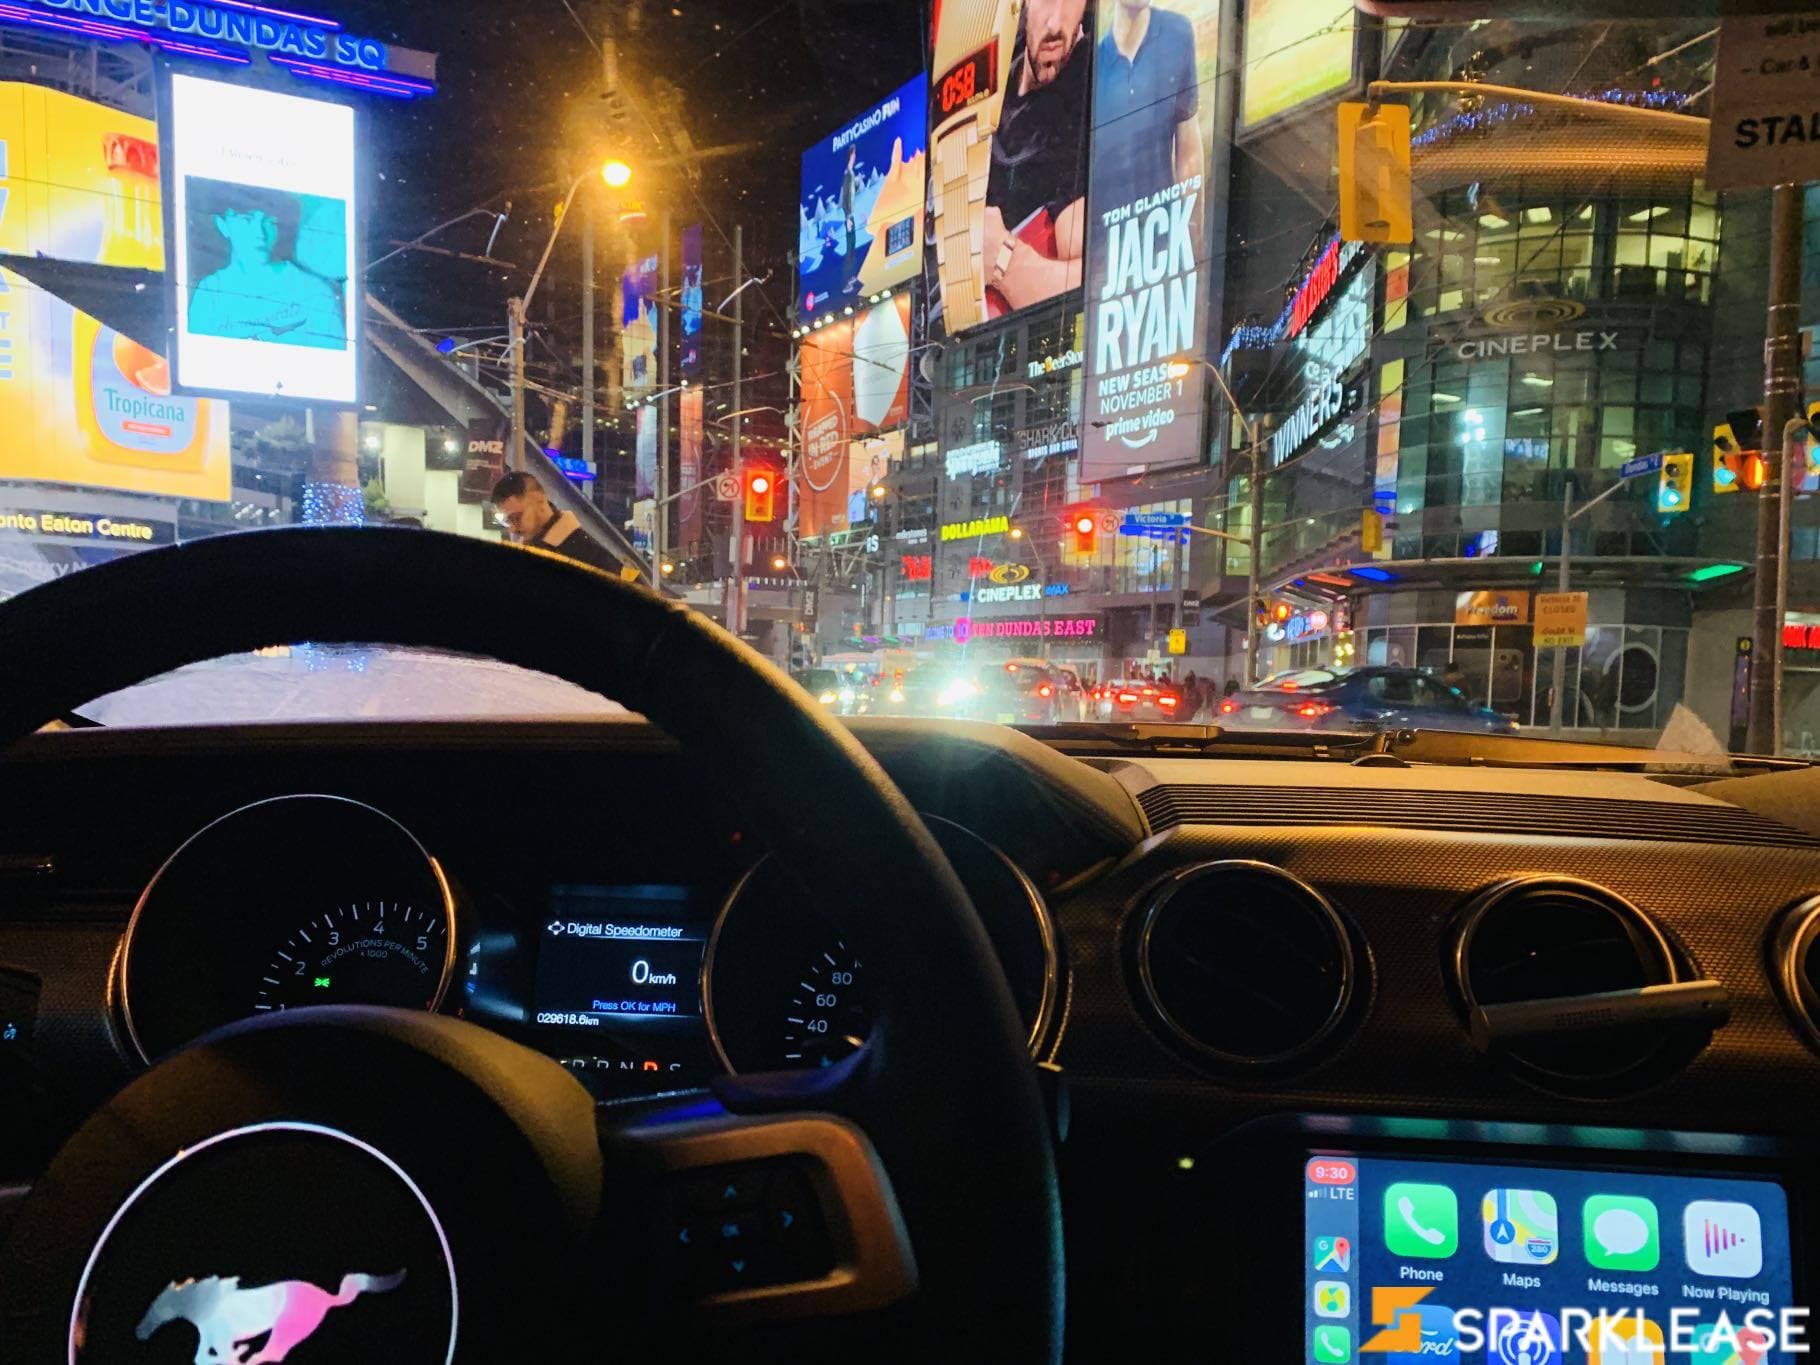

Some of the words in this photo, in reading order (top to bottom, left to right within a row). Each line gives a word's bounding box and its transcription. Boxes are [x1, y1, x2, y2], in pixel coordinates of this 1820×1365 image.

[335, 33, 386, 70] SQ
[833, 108, 882, 152] PARTYCASINO
[881, 97, 900, 122] FUN
[1103, 204, 1130, 226] TOM
[1135, 174, 1202, 216] CLANCY'S
[1102, 192, 1198, 300] JACK
[1095, 271, 1198, 375] RYAN
[1457, 331, 1619, 360] CINEPLEX
[1028, 361, 1045, 378] The
[1099, 371, 1130, 396] NEW
[104, 388, 185, 422] Tropicana
[1100, 382, 1172, 416] NOVEMBER
[1176, 379, 1183, 397] 1
[1106, 416, 1141, 441] prime
[1141, 406, 1175, 430] video
[1273, 382, 1342, 468] WINNERS
[468, 440, 504, 453] DMZ
[1020, 423, 1058, 450] SHARK
[41, 514, 93, 533] Eaton
[96, 518, 153, 540] Centre
[941, 516, 1009, 541] DOLLARAMA
[1134, 514, 1167, 524] Victoria
[977, 583, 1042, 603] CINEPLEX
[1044, 584, 1069, 597] IMAX
[999, 621, 1051, 637] DUNDAS
[1054, 619, 1096, 636] EAST
[373, 921, 384, 934] 4
[567, 922, 602, 937] Digital
[605, 923, 683, 938] Speedometer
[328, 932, 339, 945] 3
[416, 936, 427, 950] 5
[321, 939, 383, 968] REVOLUTIONS
[384, 940, 403, 951] PER
[401, 947, 428, 975] MINUTE
[295, 962, 306, 976] 2
[632, 960, 649, 983] 0
[649, 973, 676, 985] km/h
[831, 972, 853, 985] 80
[592, 1000, 619, 1011] Press
[620, 1001, 636, 1011] OK
[638, 1001, 651, 1011] for
[652, 1002, 676, 1012] MPH
[815, 994, 836, 1007] 60
[537, 1012, 599, 1026] 029618.6km
[807, 1020, 828, 1033] 40
[1315, 1166, 1348, 1180] 9:30
[1330, 1188, 1354, 1200] LTE
[1400, 1267, 1444, 1281] Phone
[1503, 1273, 1541, 1289] Maps
[1588, 1278, 1659, 1297] Messages
[1682, 1285, 1715, 1299] Now
[1717, 1287, 1770, 1305] Playing
[1416, 1331, 1455, 1356] ord
